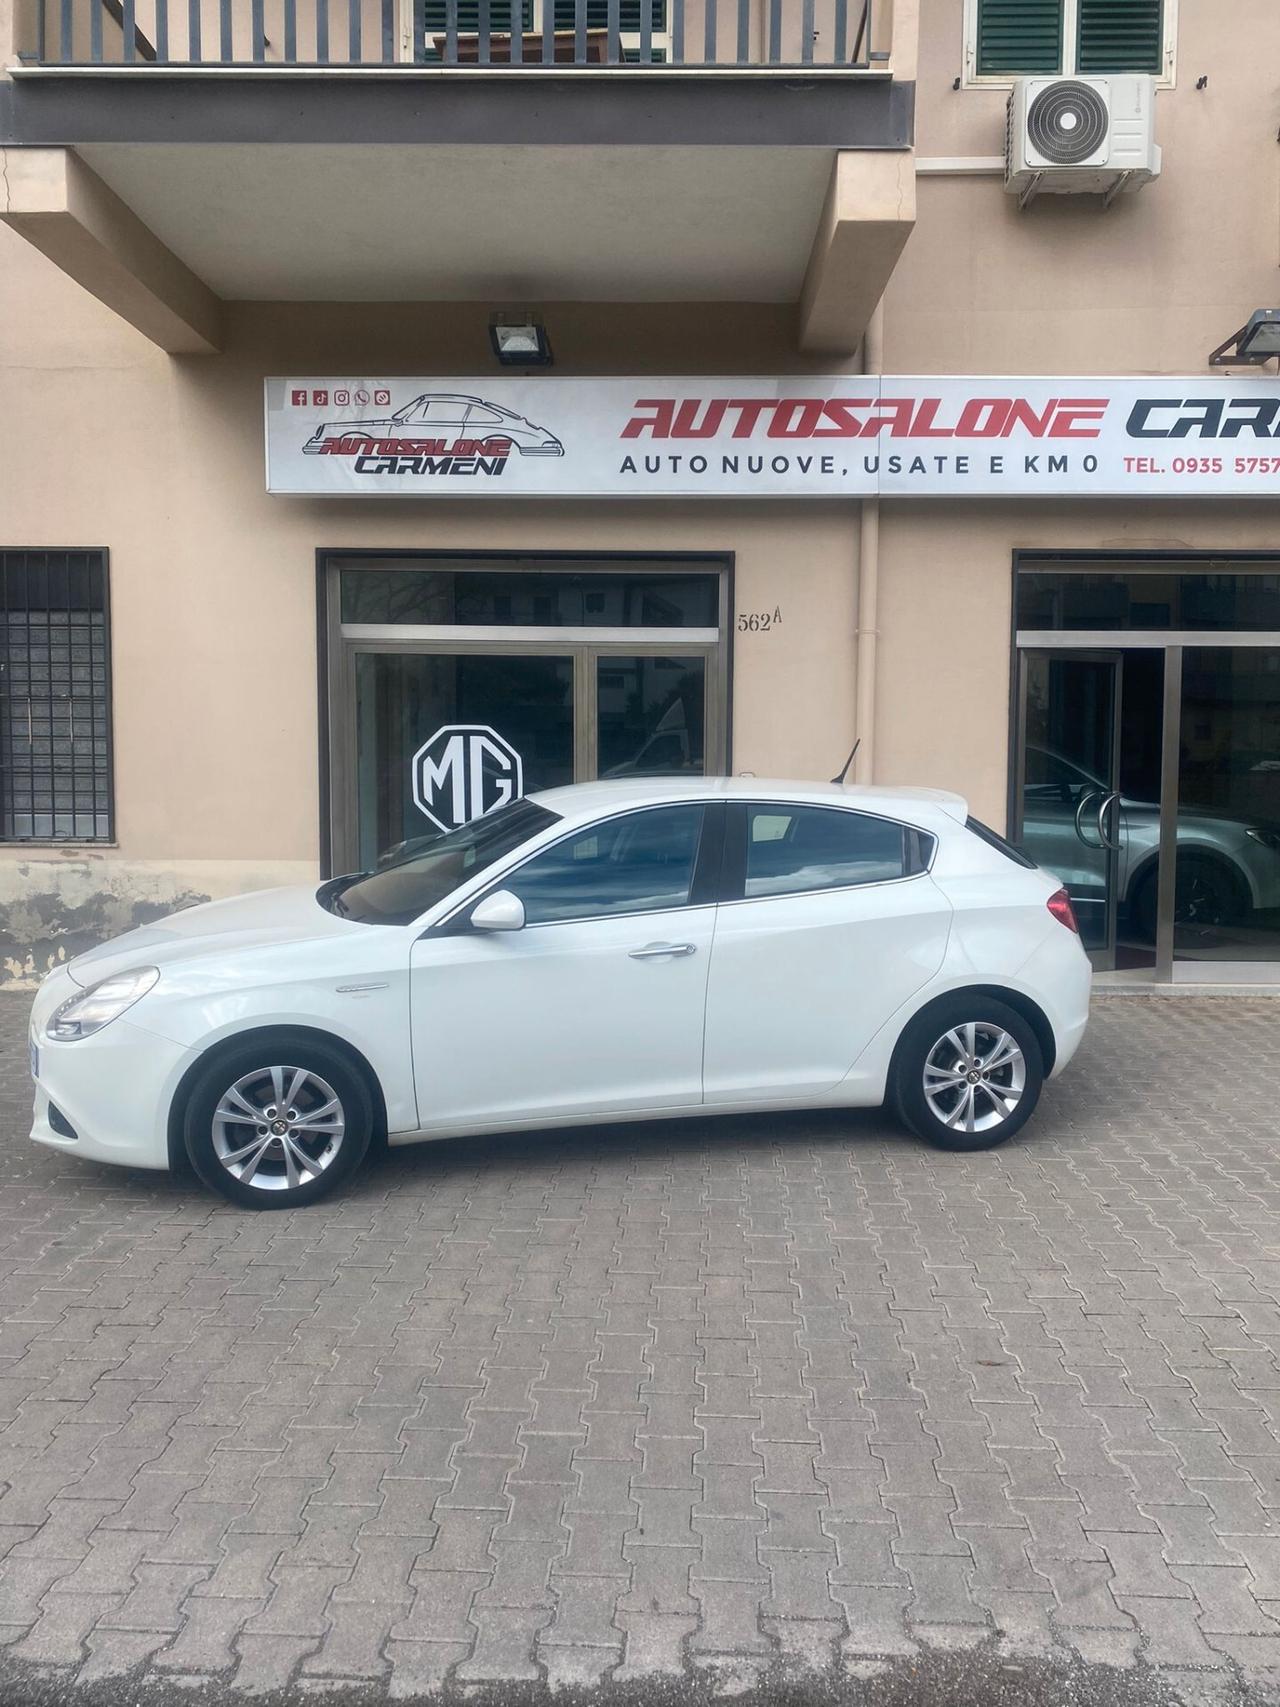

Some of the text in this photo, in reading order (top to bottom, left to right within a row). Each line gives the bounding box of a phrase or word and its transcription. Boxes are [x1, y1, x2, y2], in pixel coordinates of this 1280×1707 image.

[620, 398, 1280, 438] AUTOSALONE CAR
[320, 437, 513, 457] AUTOSALONE
[354, 457, 507, 476] CARMENI
[619, 455, 708, 474] AUTO
[722, 455, 848, 475] NUOVE,
[864, 455, 969, 474] USATE
[990, 456, 1004, 473] E
[1124, 457, 1280, 473] TEL. 0935 5757
[423, 735, 512, 824] MG
